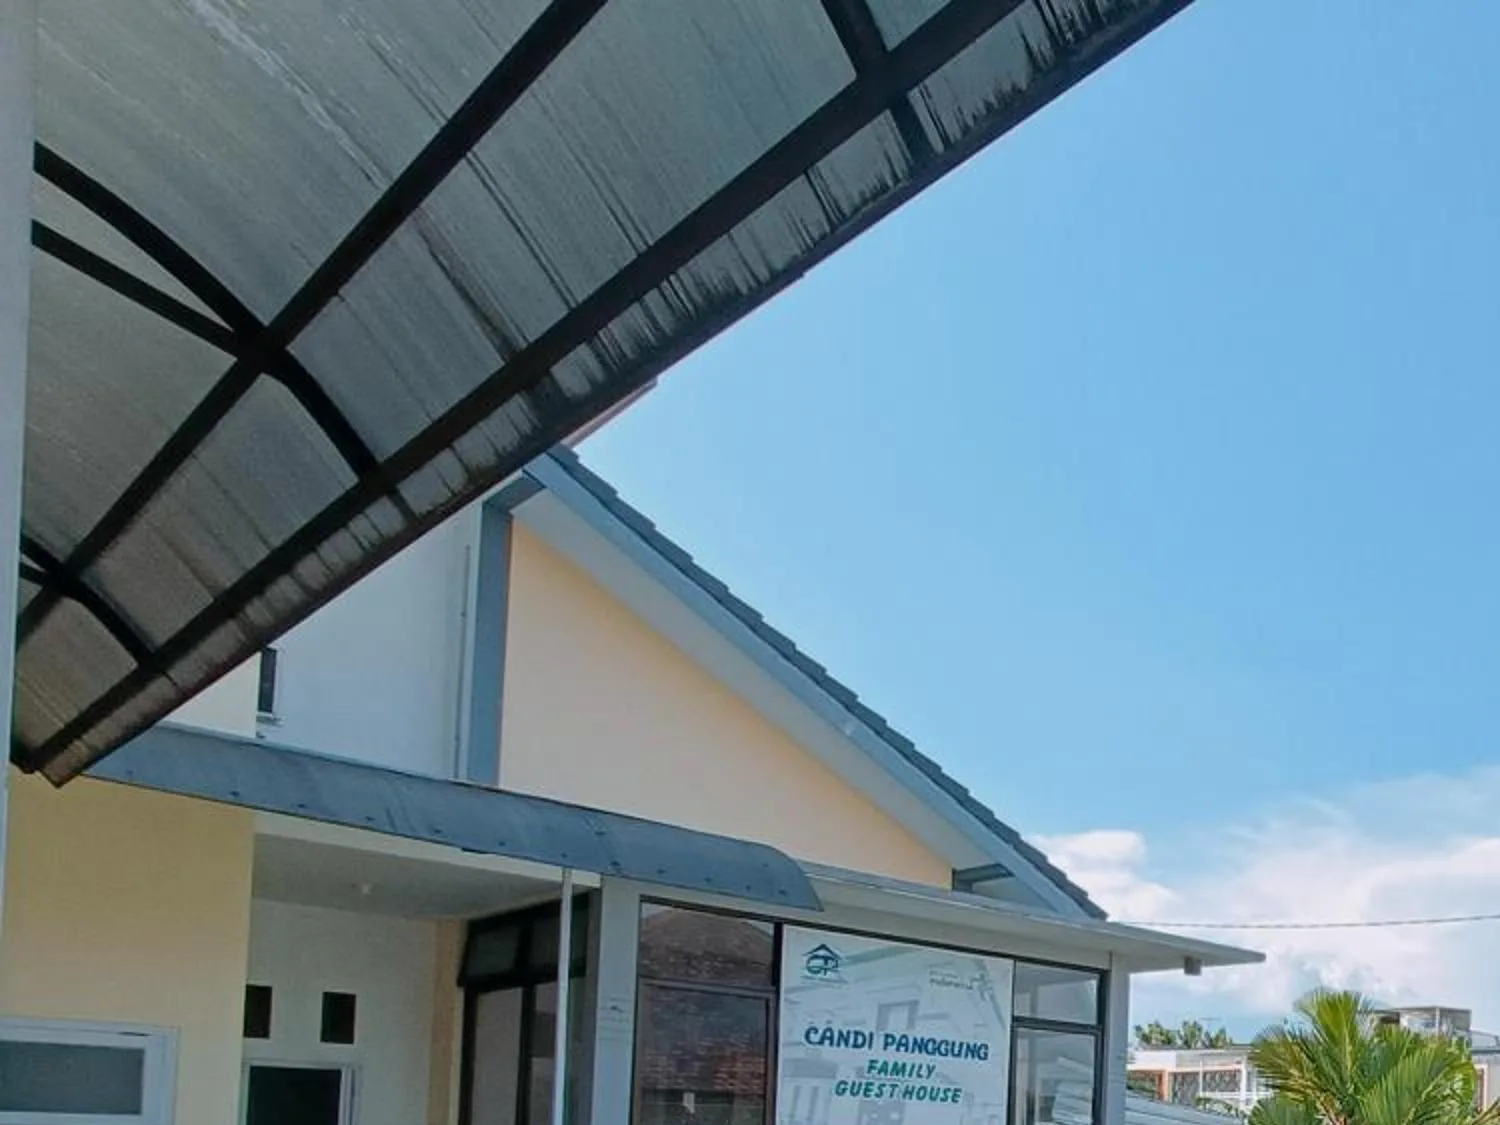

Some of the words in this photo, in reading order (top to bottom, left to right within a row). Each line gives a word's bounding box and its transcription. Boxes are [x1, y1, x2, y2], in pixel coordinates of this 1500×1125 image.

[804, 1025, 874, 1050] CANDI
[884, 1033, 989, 1061] PANGGUNG
[867, 1060, 936, 1079] FAMILY
[835, 1080, 899, 1098] GUEST
[903, 1084, 962, 1103] HOUSE
